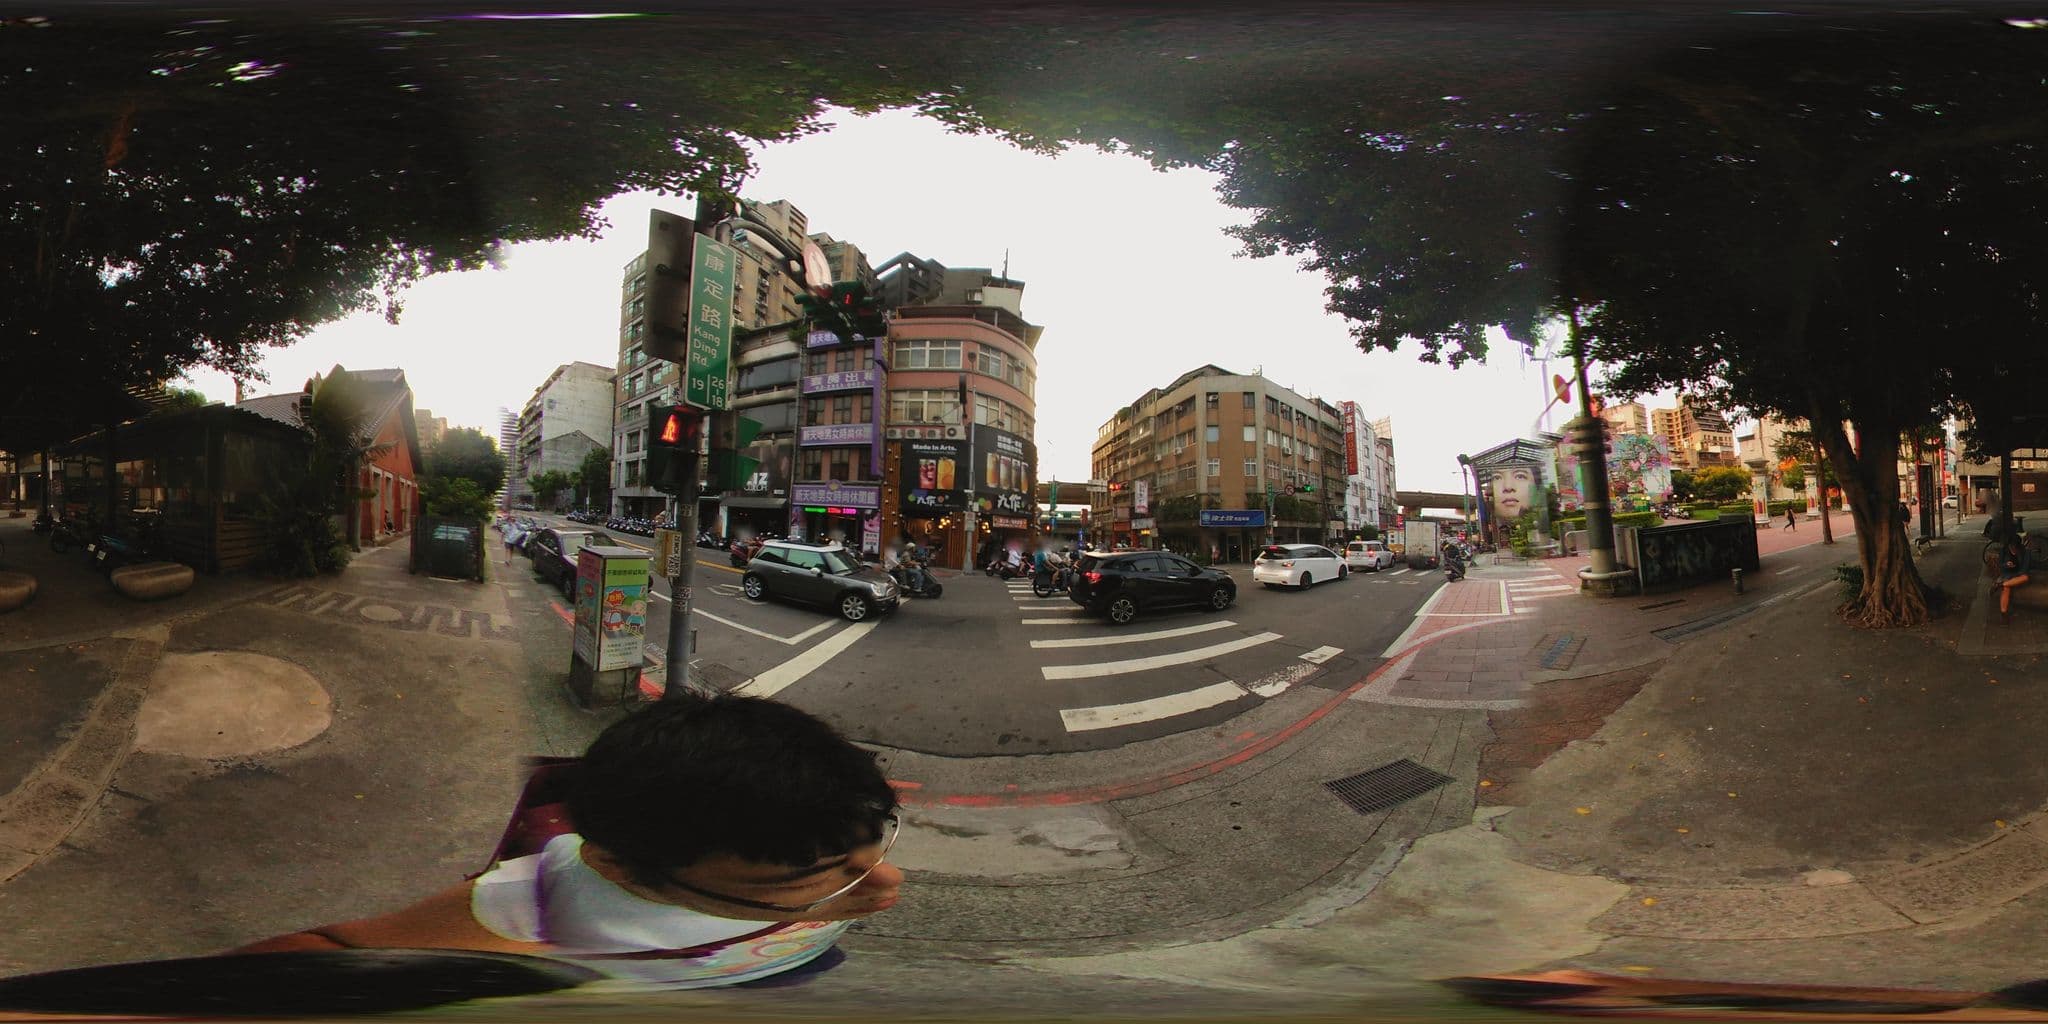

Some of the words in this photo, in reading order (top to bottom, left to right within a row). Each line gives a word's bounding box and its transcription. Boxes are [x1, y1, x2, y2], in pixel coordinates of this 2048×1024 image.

[701, 253, 726, 329] 康定路
[694, 326, 721, 347] Kang
[693, 338, 717, 359] Ding
[692, 377, 704, 390] 19
